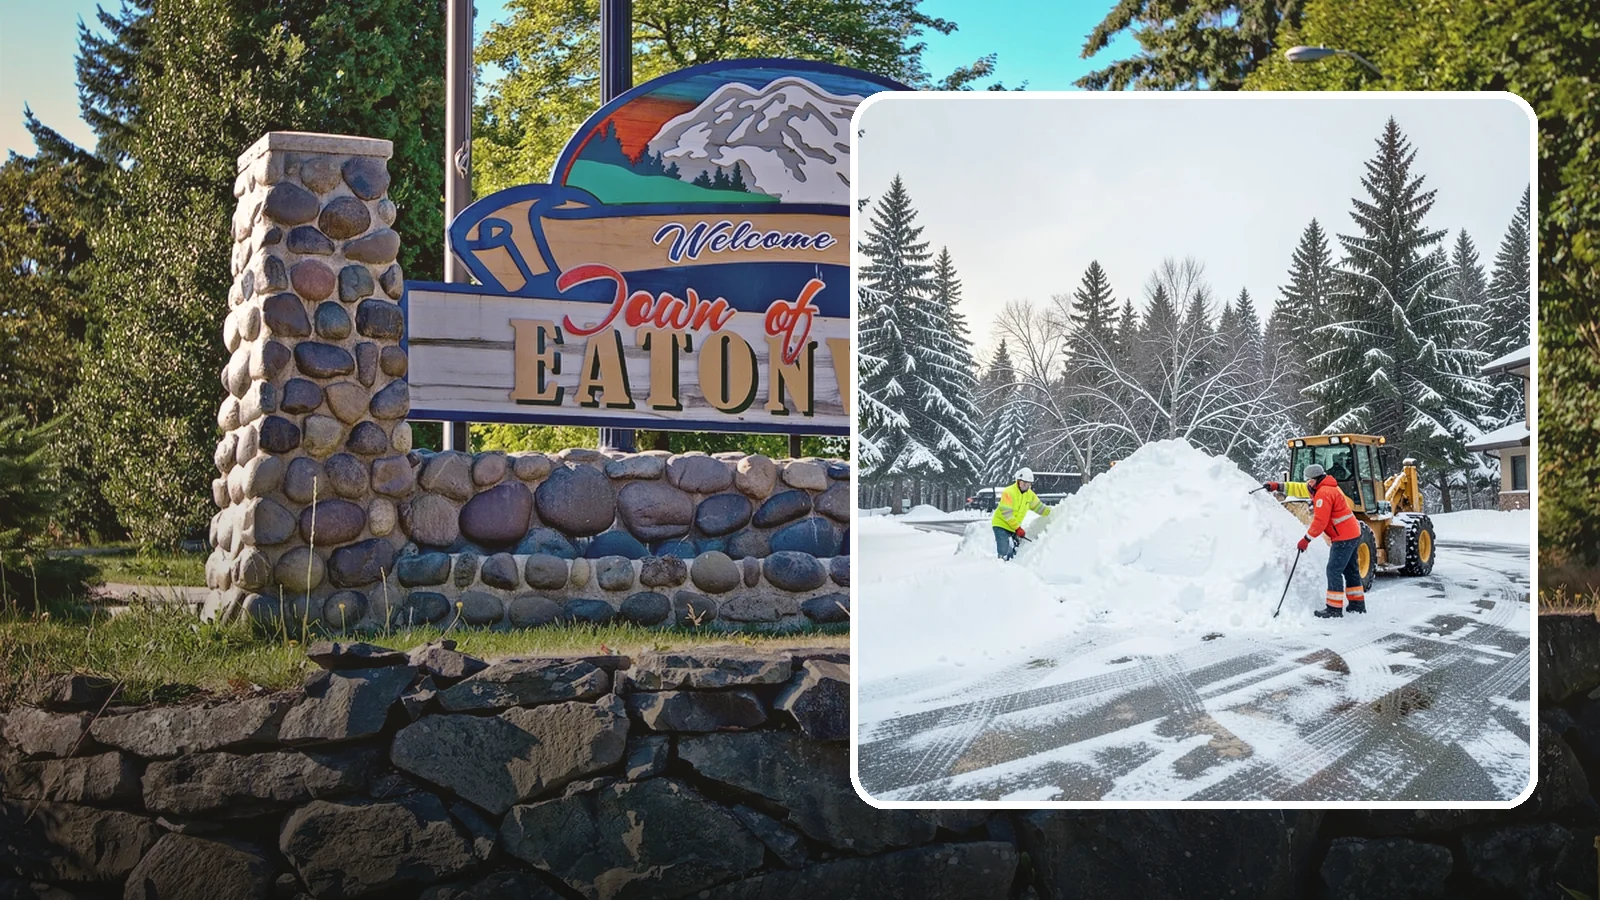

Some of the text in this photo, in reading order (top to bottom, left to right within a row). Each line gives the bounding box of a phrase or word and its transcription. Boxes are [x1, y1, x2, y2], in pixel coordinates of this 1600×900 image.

[653, 220, 837, 263] Welcome
[556, 263, 826, 366] Town of
